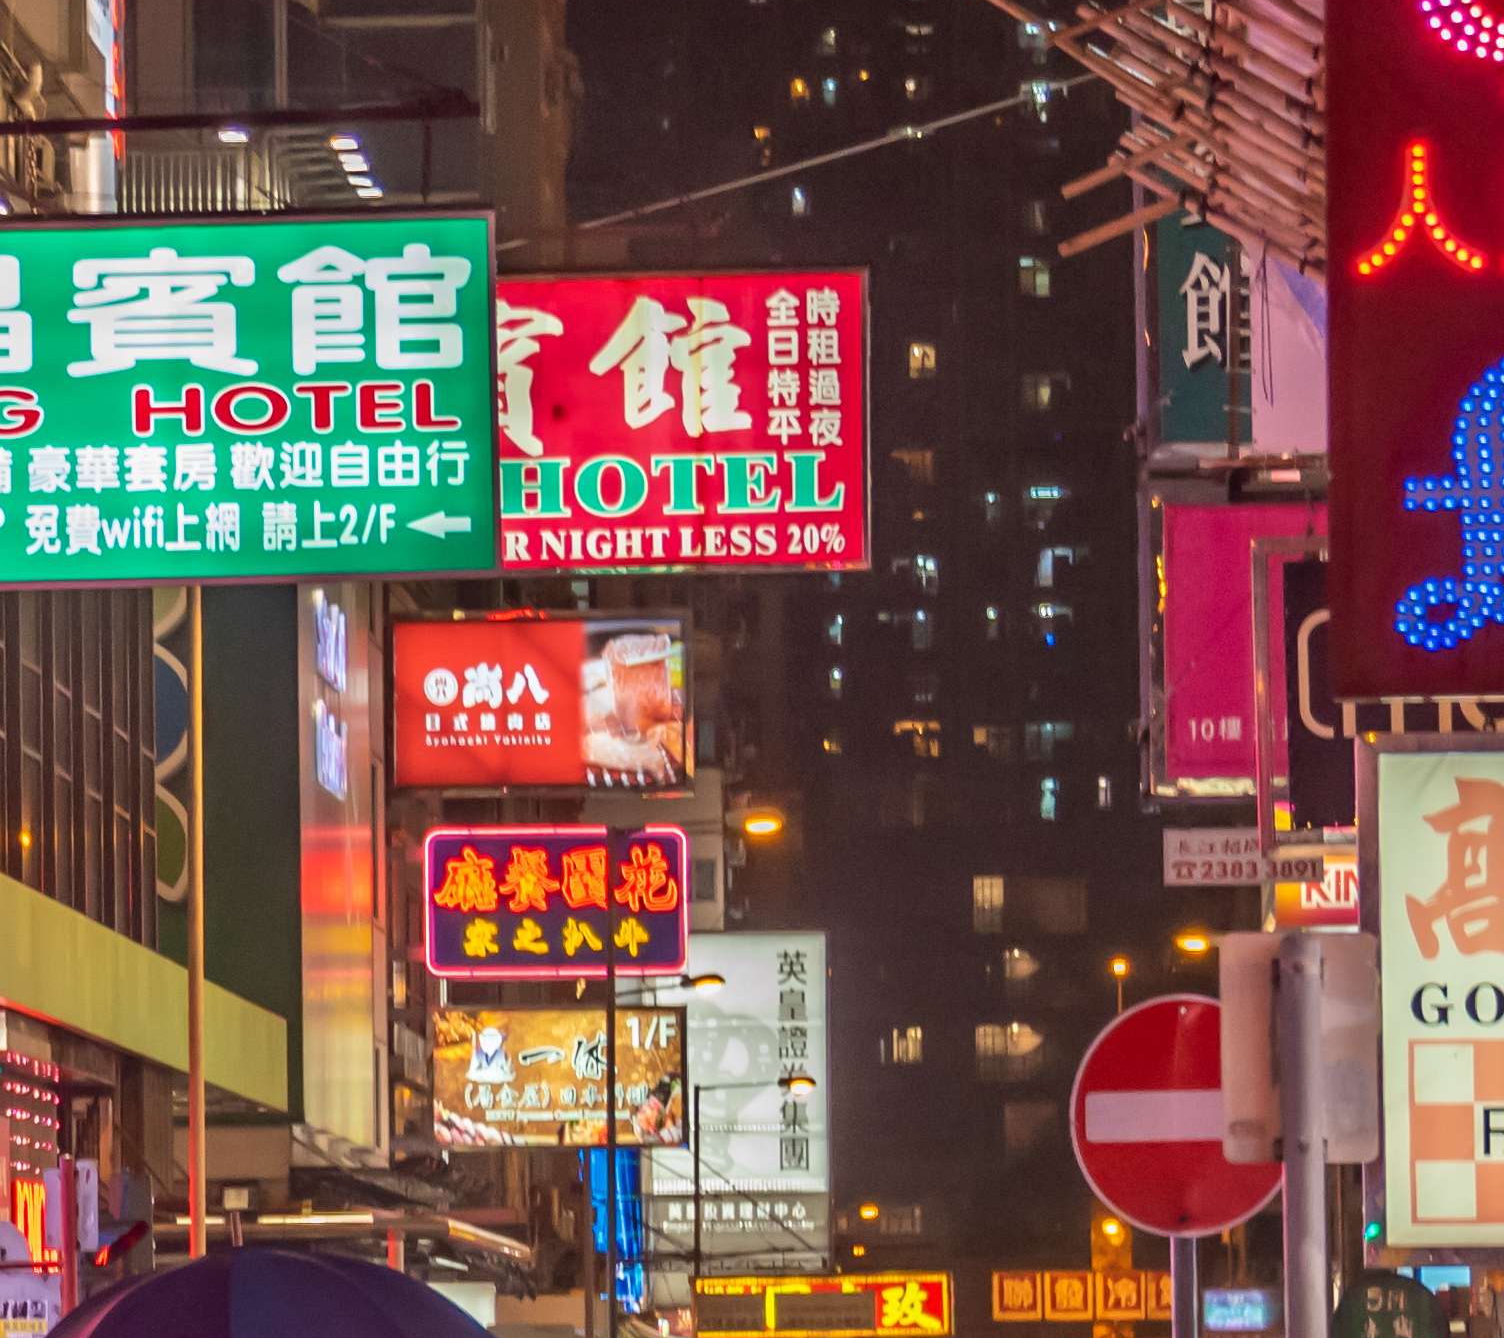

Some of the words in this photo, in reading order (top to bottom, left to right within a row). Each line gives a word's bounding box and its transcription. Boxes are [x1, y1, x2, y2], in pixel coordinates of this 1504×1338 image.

[807, 287, 842, 446] 時租過夜
[132, 379, 463, 438] HOTEL
[28, 442, 217, 494] 豪華套房
[230, 438, 471, 490] 歡迎自由行
[500, 451, 845, 518] HOTEL
[541, 527, 670, 560] NIGHT
[680, 525, 777, 557] LESS
[787, 523, 846, 554] 20%
[626, 1016, 676, 1049] 1/F
